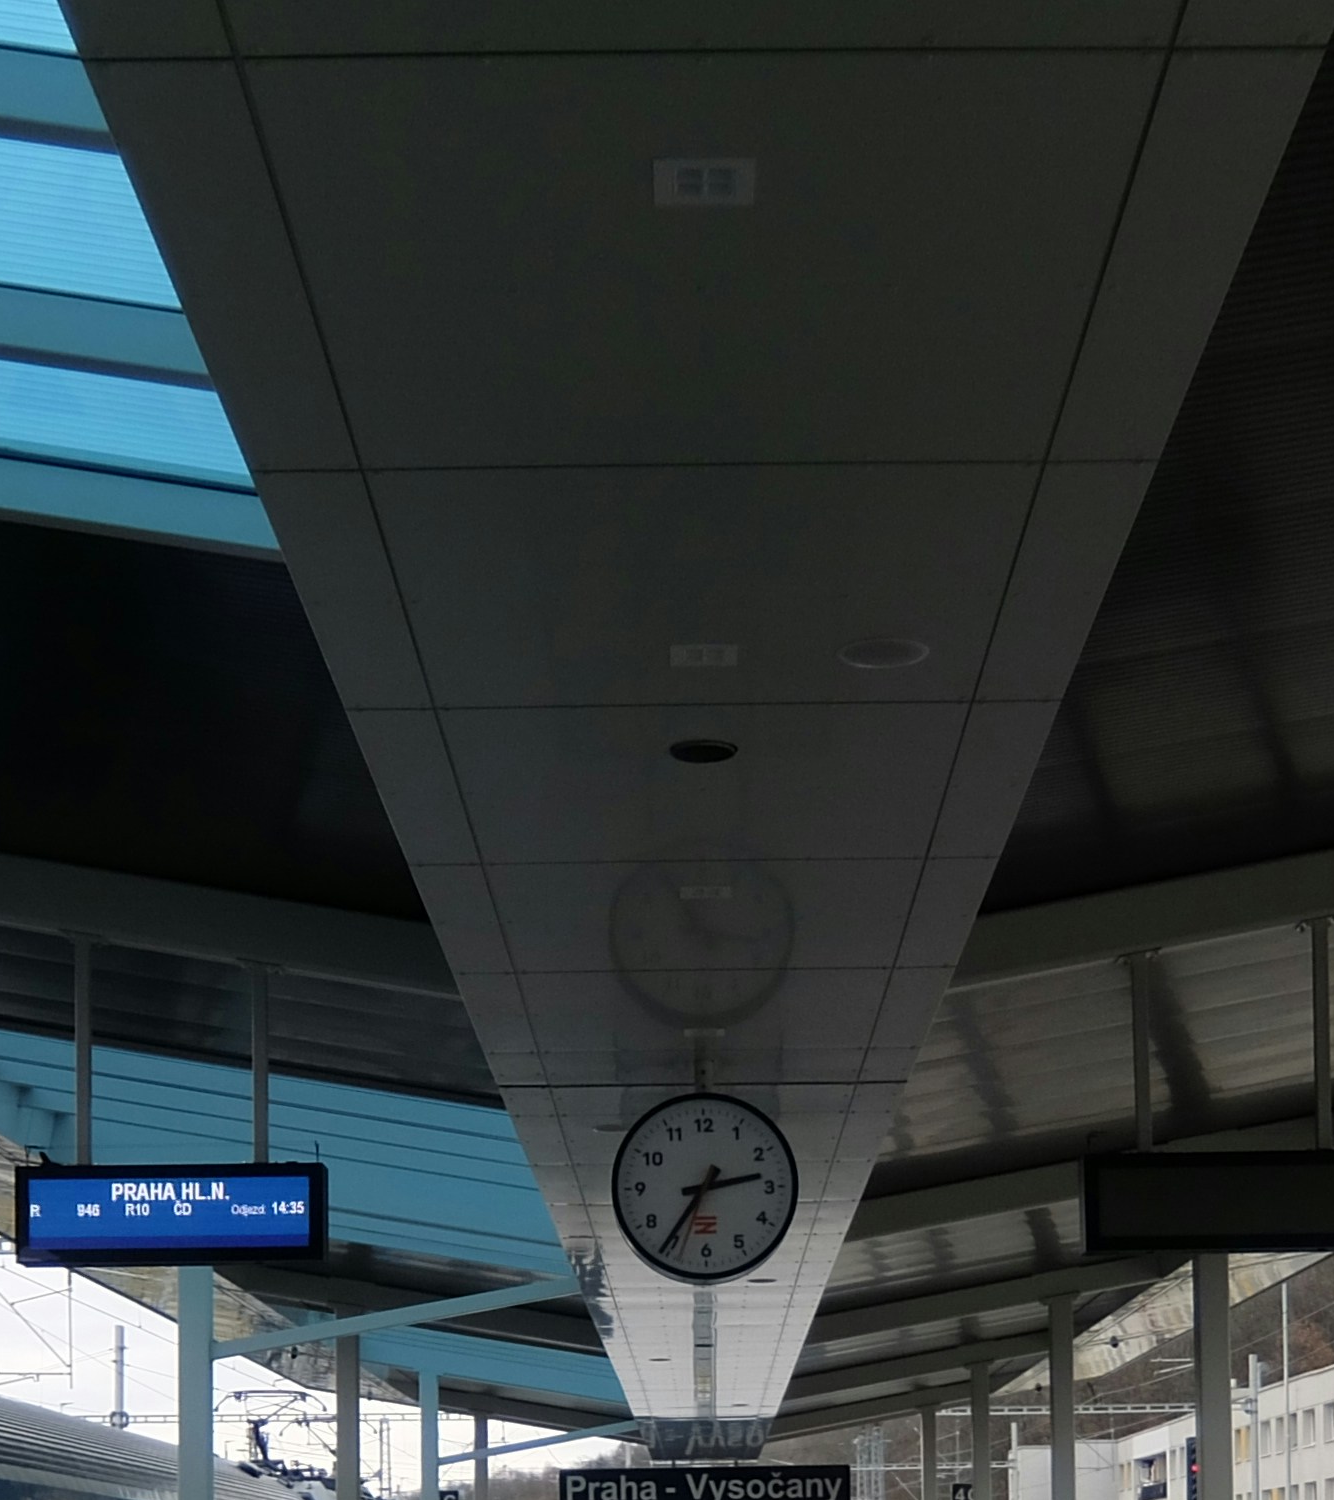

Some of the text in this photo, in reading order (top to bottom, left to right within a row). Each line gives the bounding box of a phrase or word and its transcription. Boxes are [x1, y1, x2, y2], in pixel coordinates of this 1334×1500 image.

[694, 1118, 714, 1133] 12
[732, 1126, 740, 1140] 1
[667, 1127, 682, 1142] 11
[643, 1151, 663, 1167] 10
[754, 1147, 765, 1161] 2
[111, 1181, 230, 1201] PRAHA HL.N.
[635, 1182, 646, 1196] 9
[764, 1180, 775, 1194] 3
[30, 1204, 41, 1217] R
[125, 1203, 150, 1216] R10
[174, 1200, 192, 1216] ČD
[272, 1201, 304, 1215] 14:35
[646, 1214, 657, 1228] 8
[756, 1211, 768, 1225] 4
[734, 1234, 744, 1249] 5
[700, 1243, 712, 1258] 6
